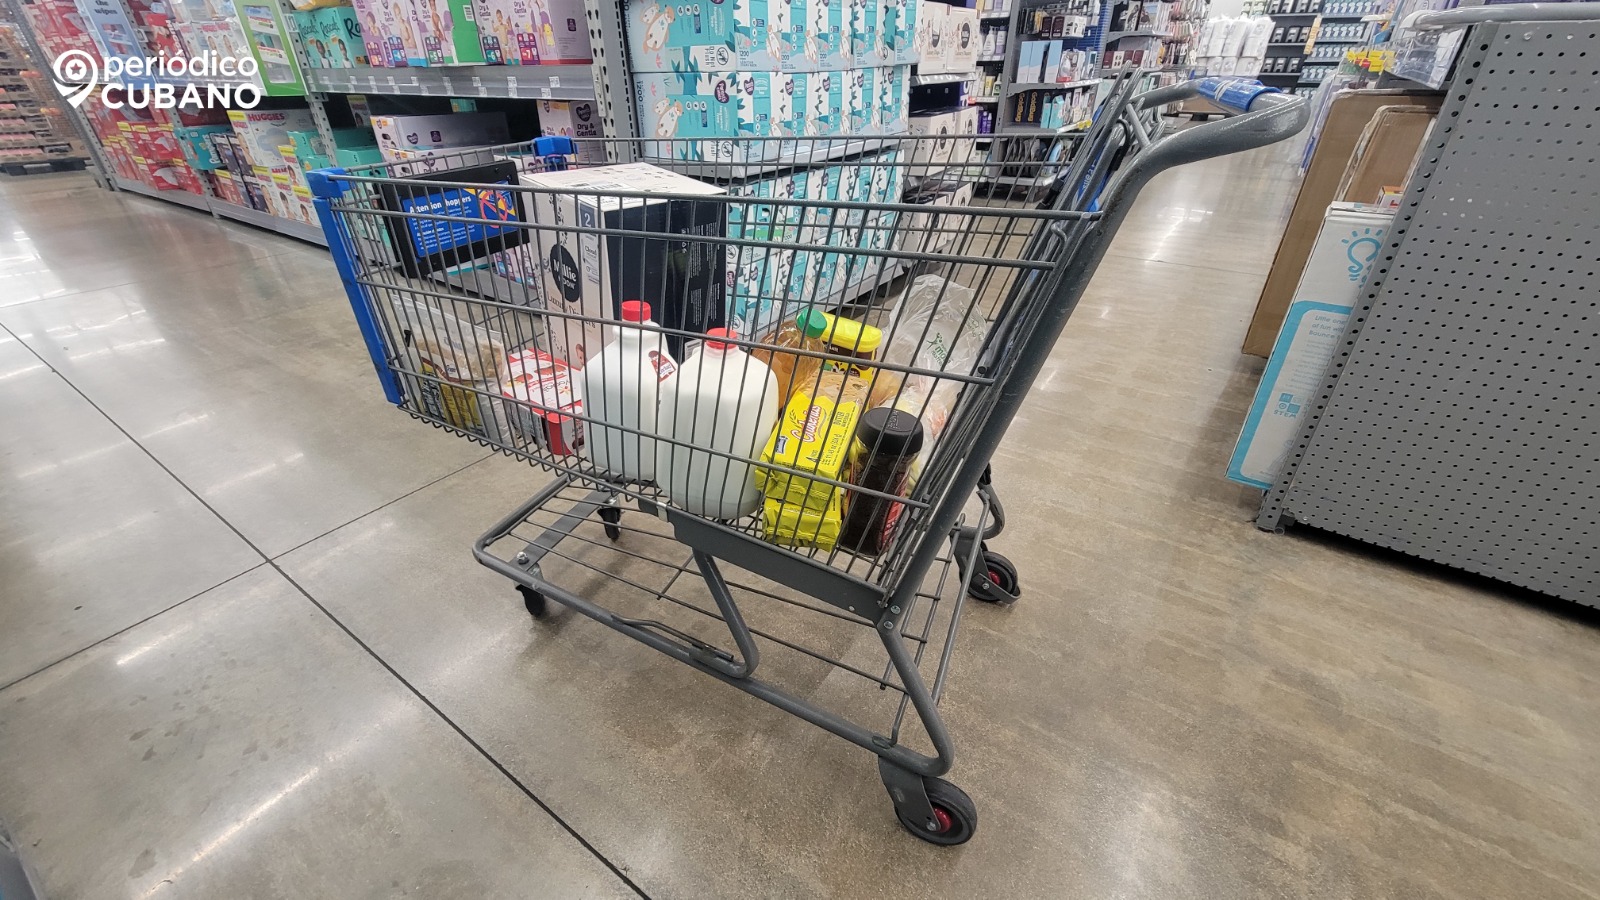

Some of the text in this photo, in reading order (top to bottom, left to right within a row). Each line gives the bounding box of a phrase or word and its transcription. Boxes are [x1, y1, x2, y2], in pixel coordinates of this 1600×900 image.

[247, 113, 285, 121] HUGGIES
[409, 195, 472, 214] Atenion hopers
[584, 212, 592, 227] 2
[553, 258, 577, 282] Mllie
[1274, 410, 1297, 419] STEM
